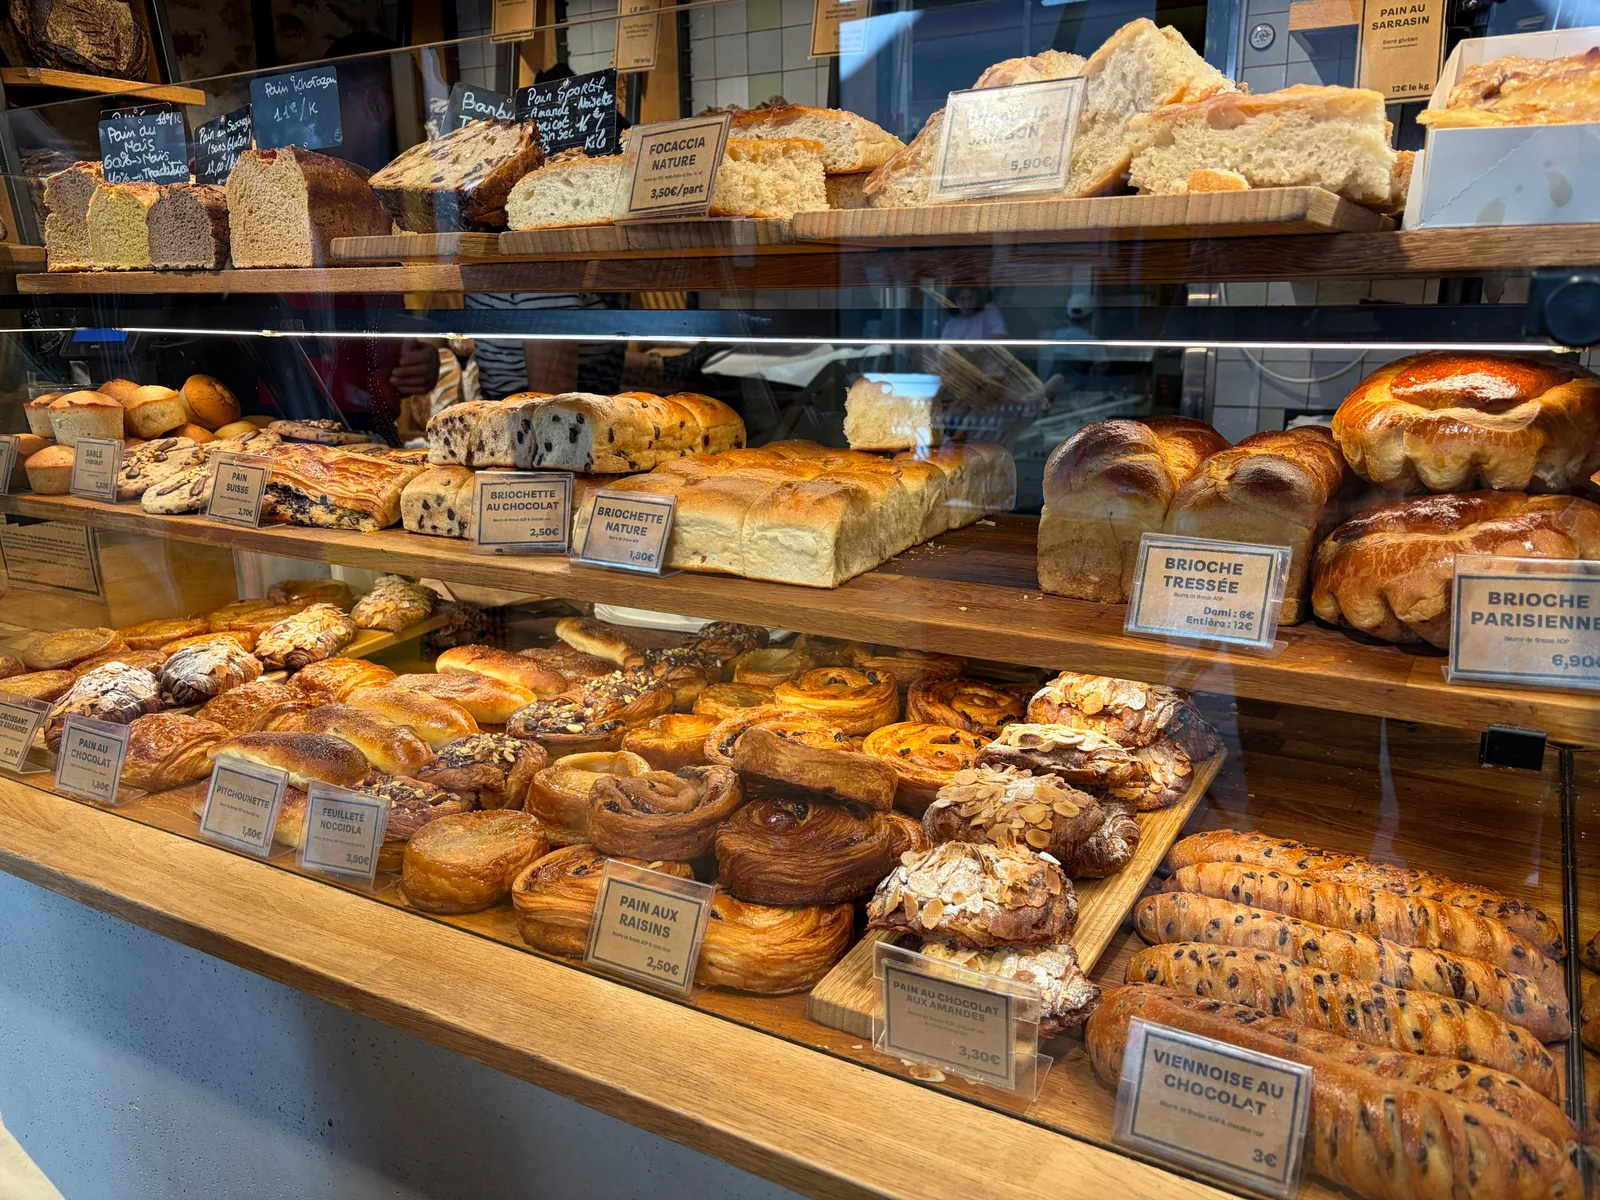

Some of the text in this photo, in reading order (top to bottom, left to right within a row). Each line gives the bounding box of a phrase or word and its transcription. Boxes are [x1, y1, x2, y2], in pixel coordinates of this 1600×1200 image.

[1380, 4, 1425, 17] PAIN AU
[1372, 16, 1430, 30] SARRASIN
[1398, 36, 1418, 44] gluten
[265, 81, 289, 97] Pain
[527, 76, 606, 106] Pain Sportif
[1392, 84, 1407, 92] 12€
[1418, 83, 1429, 91] kg
[107, 125, 156, 143] Pain du
[199, 126, 214, 145] Pain
[584, 127, 607, 151] Kilo
[650, 137, 705, 155] FOCACCIA
[652, 154, 697, 170] NATURE
[1011, 156, 1052, 173] 5,90€
[650, 183, 704, 200] 3,50€/part
[86, 449, 103, 458] SABLÉ
[232, 472, 248, 482] PAIN
[226, 483, 249, 494] SUISSE
[491, 490, 556, 500] BRIOCHETTE
[238, 507, 253, 517] 2,70€
[486, 502, 560, 511] AU CHOCOLAT
[597, 506, 664, 524] BRIOCHETTE
[530, 528, 559, 538] 2,50€
[605, 521, 648, 537] NATURE
[630, 550, 654, 562] 1,80€
[1164, 557, 1244, 576] BRIOCHE
[1163, 575, 1240, 594] TRESSÉE
[1488, 592, 1590, 609] BRIOCHE
[1204, 606, 1232, 618] Demi
[1239, 610, 1254, 620] 6€
[1186, 615, 1226, 628] Entière
[1233, 620, 1253, 631] 12€
[0, 712, 28, 725] CROISSANT
[3, 721, 28, 734] AMANDES
[78, 738, 108, 754] PAIN AU
[71, 749, 112, 768] CHOCOLAT
[216, 785, 270, 809] PITCHOUNETTE
[323, 807, 365, 822] FEUILLETÉ
[242, 826, 262, 840] 1,80€
[320, 820, 362, 835] NOCCIOLA
[346, 853, 370, 866] 3,90€
[620, 895, 679, 922] PAIN AUX
[619, 913, 671, 939] RAISINS
[646, 957, 680, 976] 2,50€
[893, 981, 1000, 1016] PAIN AU CHOCOLAT
[906, 994, 986, 1022] AUX AMANDES
[958, 1045, 1000, 1065] 3,30€
[1154, 1049, 1284, 1099] VIENNOISE AU
[1164, 1074, 1267, 1116] CHOCOLAT
[1252, 1149, 1277, 1168] 3€
